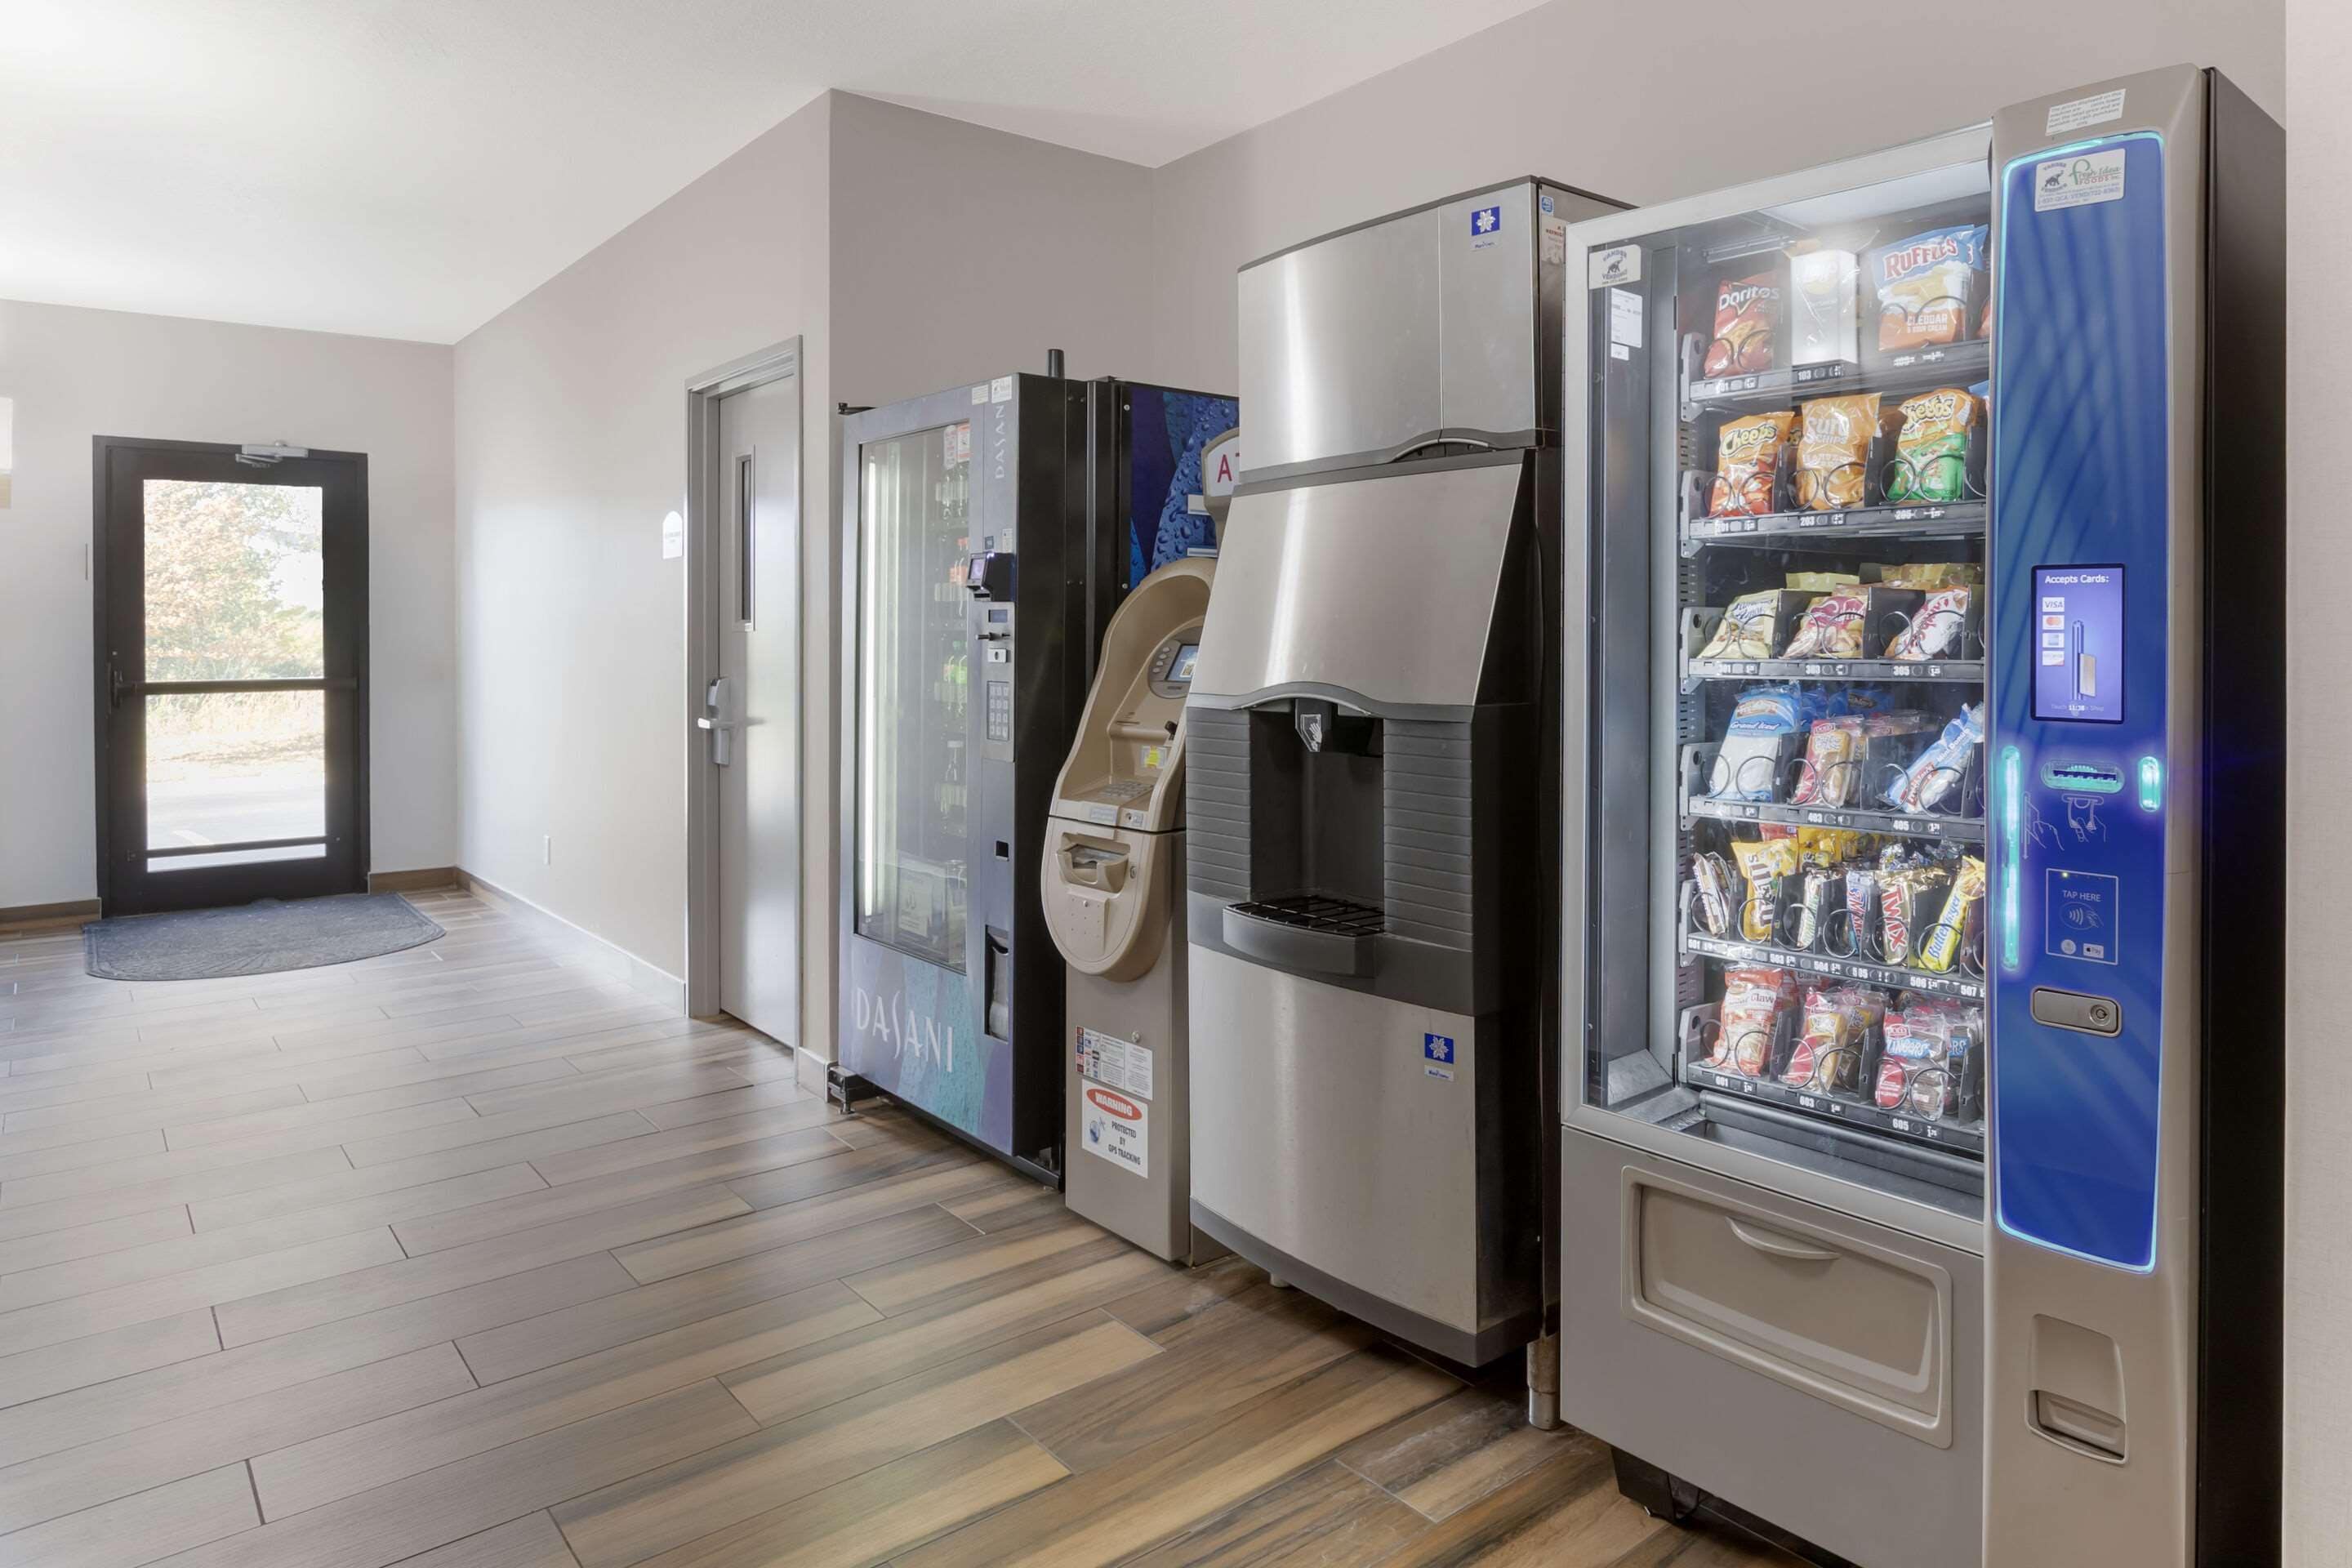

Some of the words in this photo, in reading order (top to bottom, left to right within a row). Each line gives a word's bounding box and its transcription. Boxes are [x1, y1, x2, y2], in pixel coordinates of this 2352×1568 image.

[2079, 175, 2110, 185] FOODS
[1884, 238, 1958, 280] RUFFLES
[1719, 286, 1780, 310] Doritos
[1720, 422, 1779, 458] Cheetos
[1800, 515, 1815, 527] 203
[2044, 575, 2078, 586] Accepts
[2080, 574, 2109, 583] Cards:
[2044, 600, 2064, 608] VISA
[1893, 820, 1909, 831] 405
[2062, 889, 2078, 898] TAP
[2079, 893, 2101, 902] HERE
[1882, 884, 1909, 951] TWIX
[1927, 893, 1961, 959] Butterfinger
[1960, 984, 1976, 995] 507
[857, 987, 954, 1074] DASANI
[1716, 1076, 1729, 1087] 601
[1094, 1091, 1133, 1117] WARNING
[1799, 1095, 1815, 1107] 603
[1111, 1120, 1137, 1138] PROTECTED
[1892, 1118, 1909, 1131] 605
[1119, 1135, 1126, 1147] BY
[1107, 1143, 1118, 1155] GPS
[1117, 1147, 1142, 1165] TRACKING
